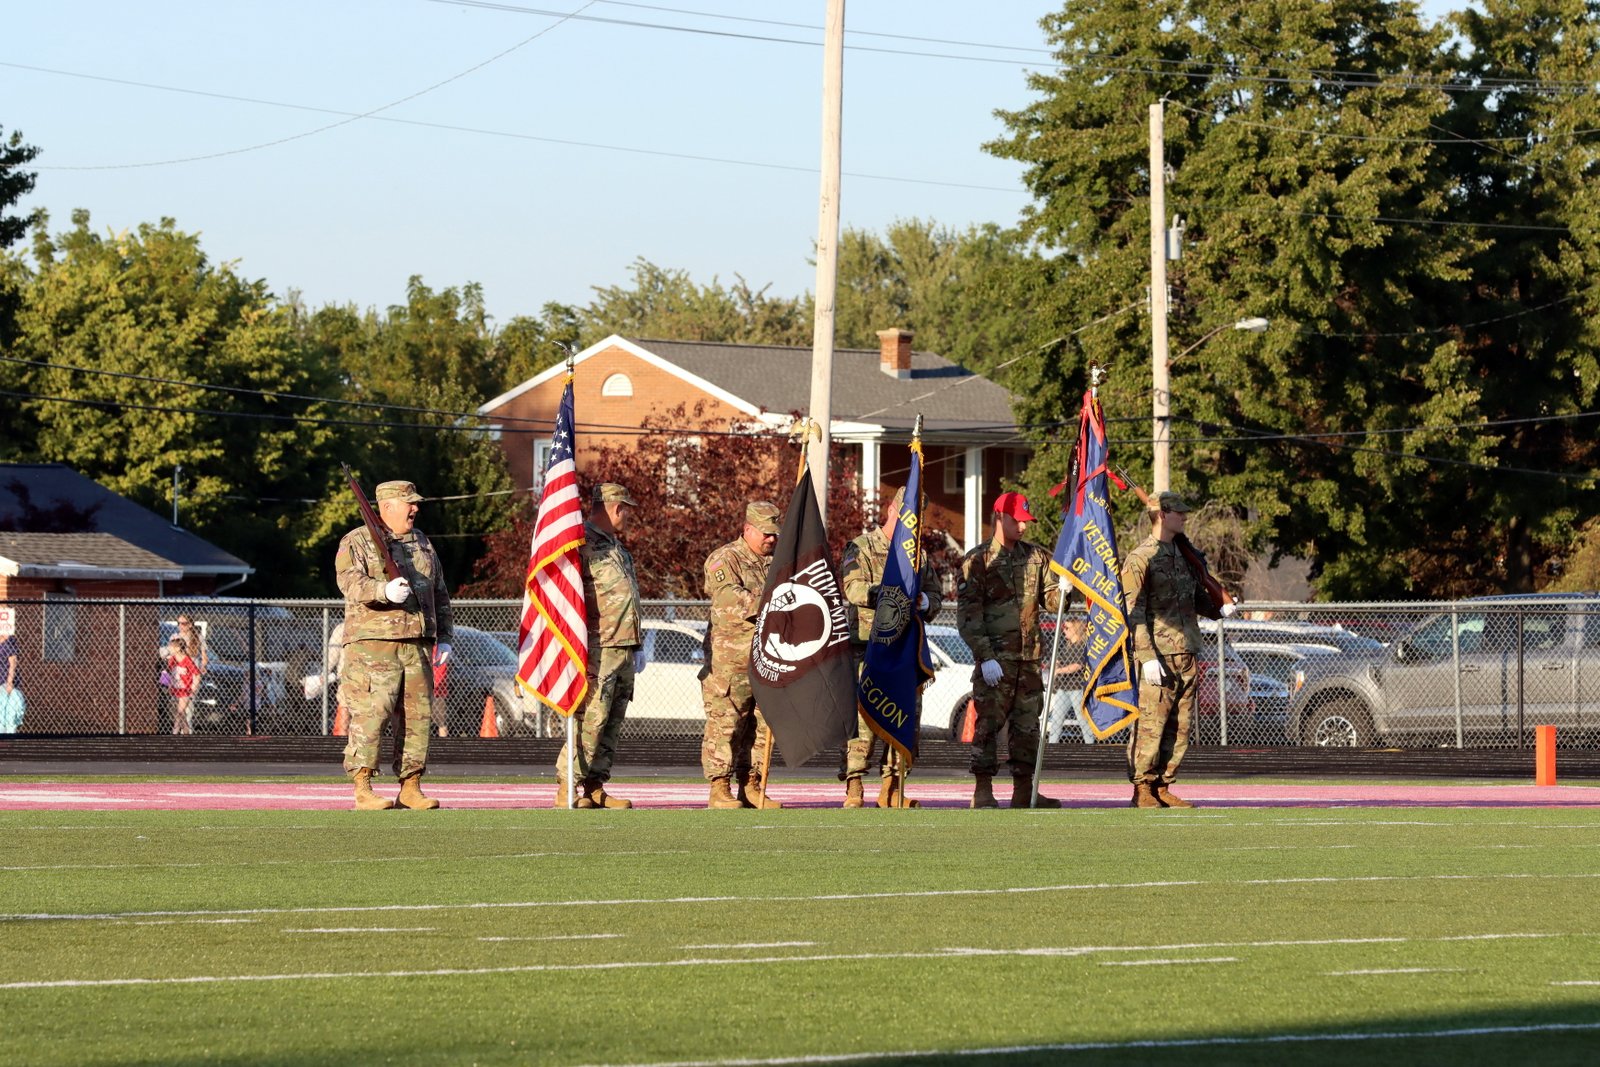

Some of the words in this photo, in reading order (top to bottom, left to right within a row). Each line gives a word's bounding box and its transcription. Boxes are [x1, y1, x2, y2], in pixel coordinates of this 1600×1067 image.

[1083, 519, 1120, 582] VETERAN
[1072, 557, 1092, 575] OF
[1091, 570, 1116, 596] THE
[789, 558, 841, 597] POW
[826, 605, 851, 648] MIA
[1094, 609, 1107, 625] OF
[1087, 634, 1110, 660] THE
